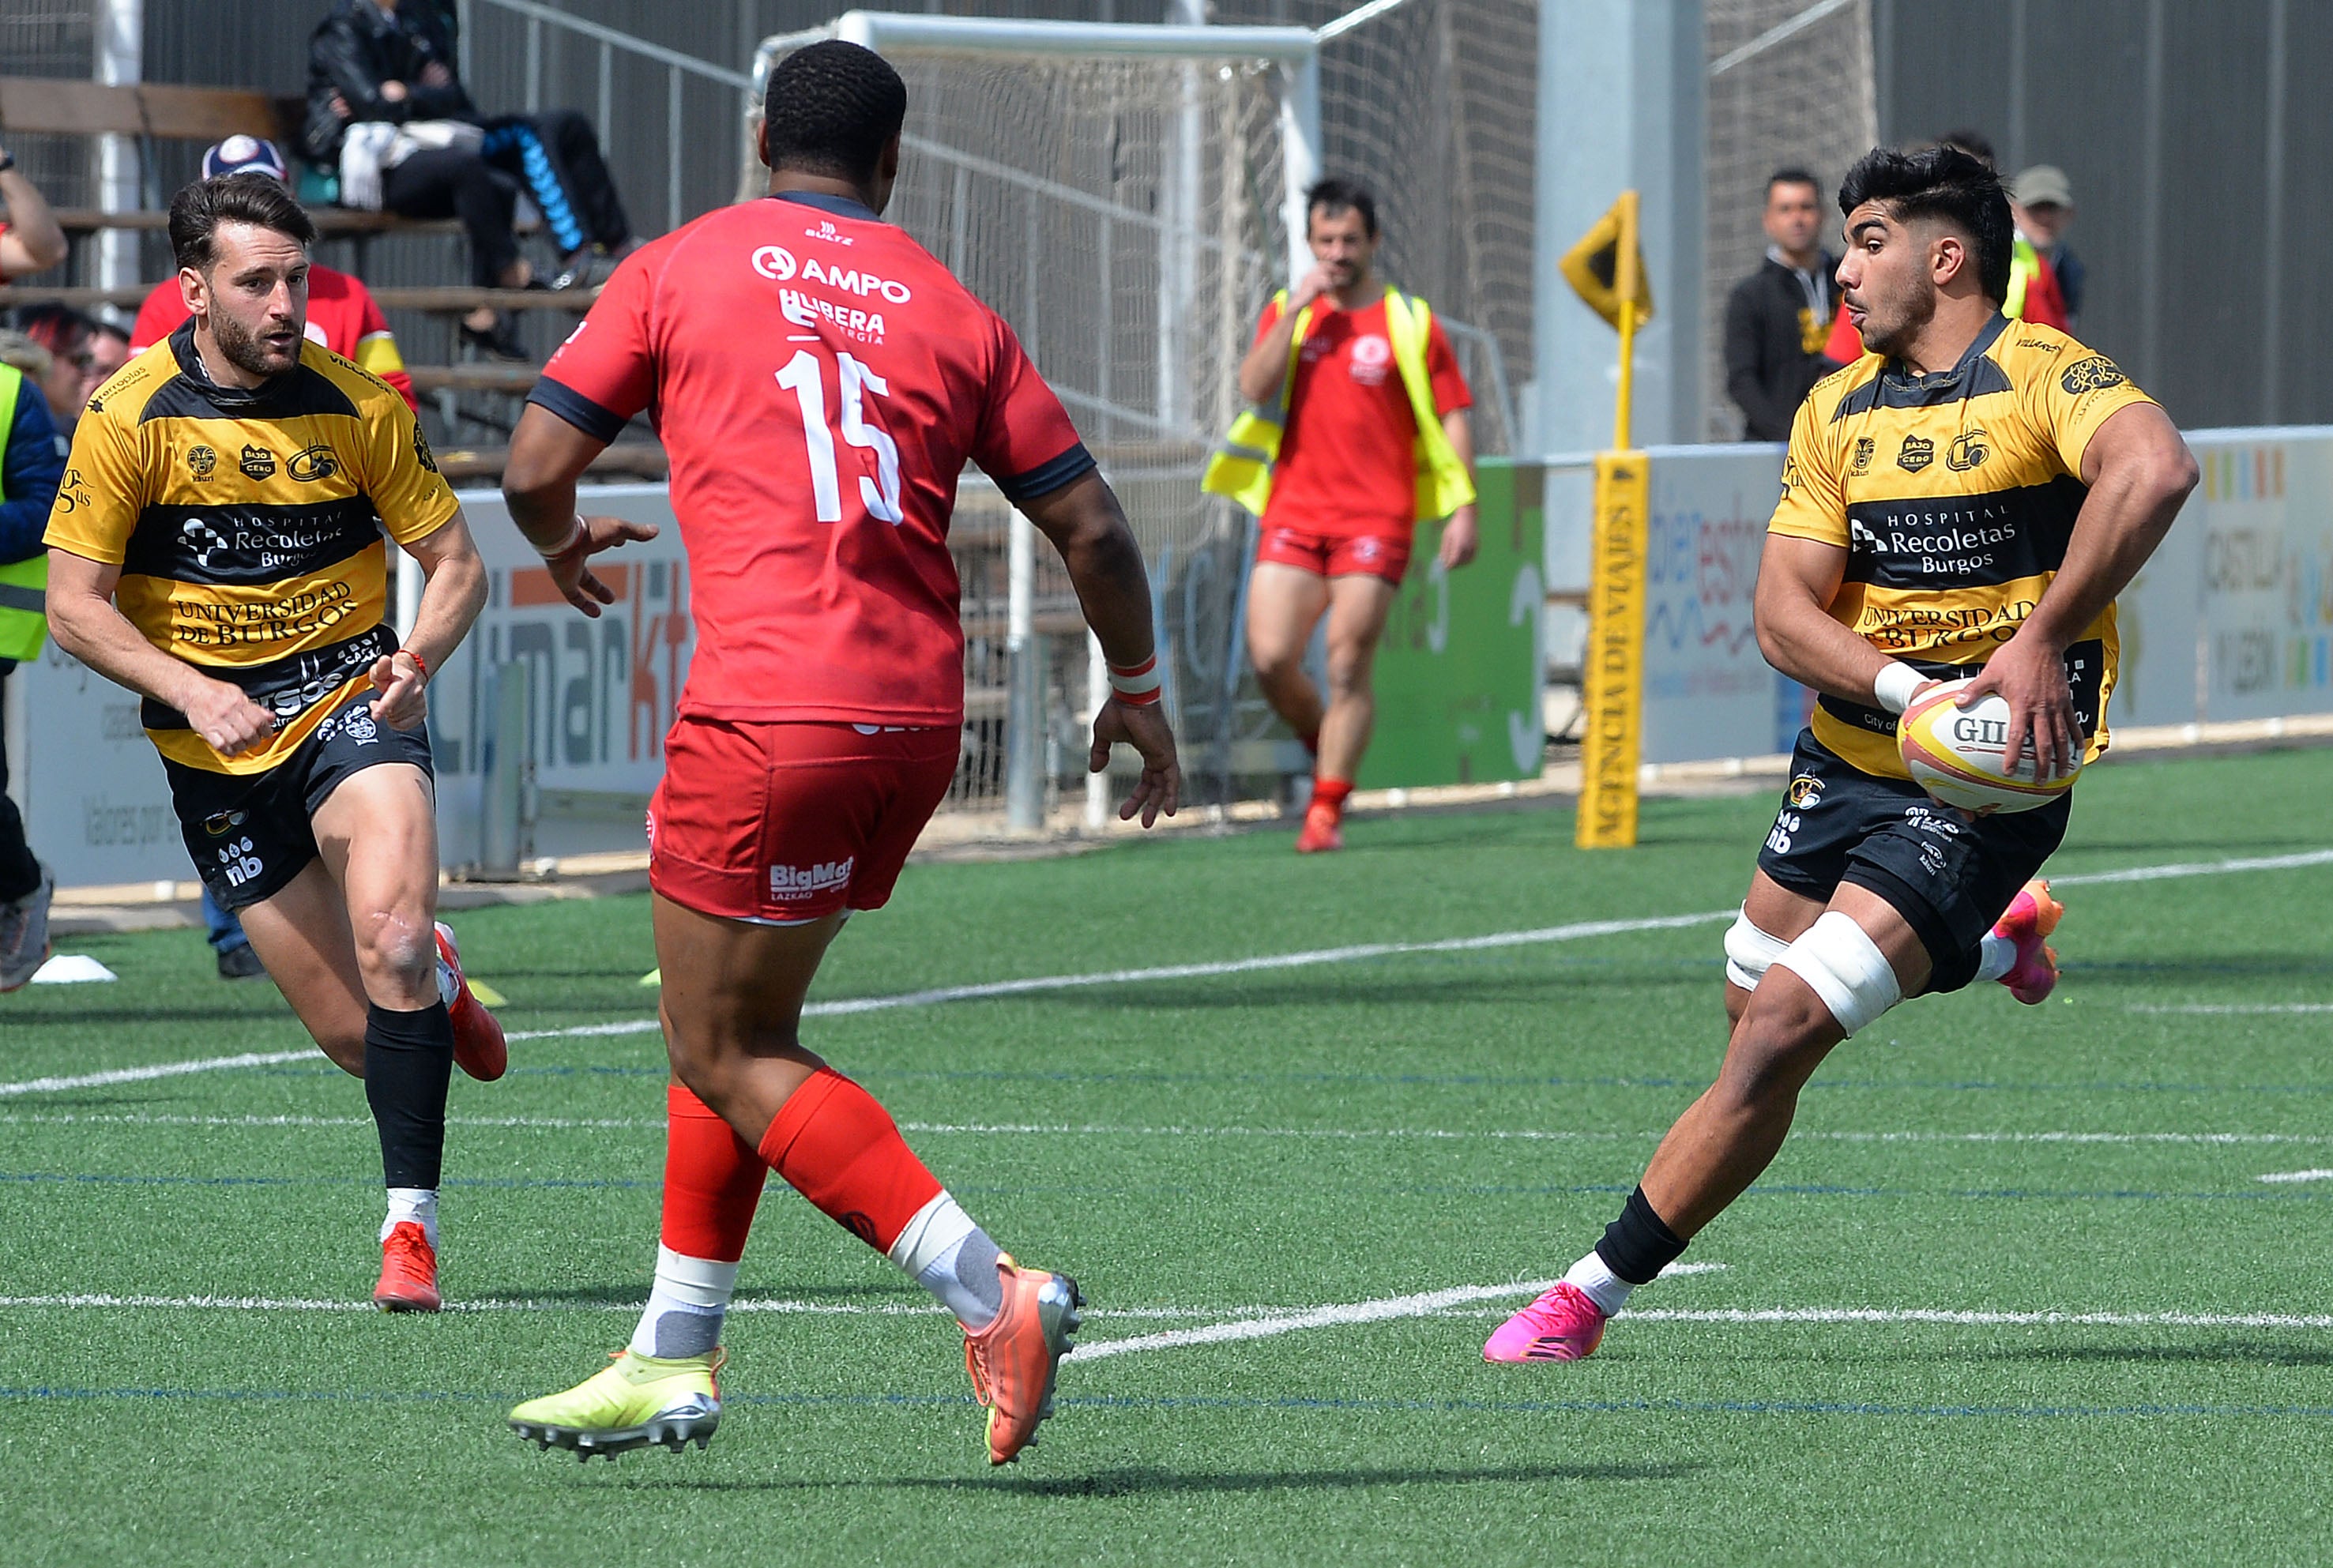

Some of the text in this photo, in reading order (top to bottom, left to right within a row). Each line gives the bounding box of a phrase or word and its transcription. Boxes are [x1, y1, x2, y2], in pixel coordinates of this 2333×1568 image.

[801, 258, 912, 304] AMPO
[799, 292, 886, 336] LIBERA
[773, 349, 905, 528] 15
[1905, 441, 1932, 451] BAJO
[1902, 455, 1930, 464] CERO
[1887, 505, 2010, 528] HOSPITAL
[1890, 523, 2016, 554] Recoletas
[1921, 553, 1994, 575] Burgos
[175, 581, 352, 623] UNIVERSIDAD
[1863, 600, 2036, 629] UNIVERSIDAD
[178, 599, 359, 646] DE BURGOS
[1883, 624, 2017, 649] BURGO
[1864, 713, 1897, 731] City of
[226, 855, 263, 887] nb
